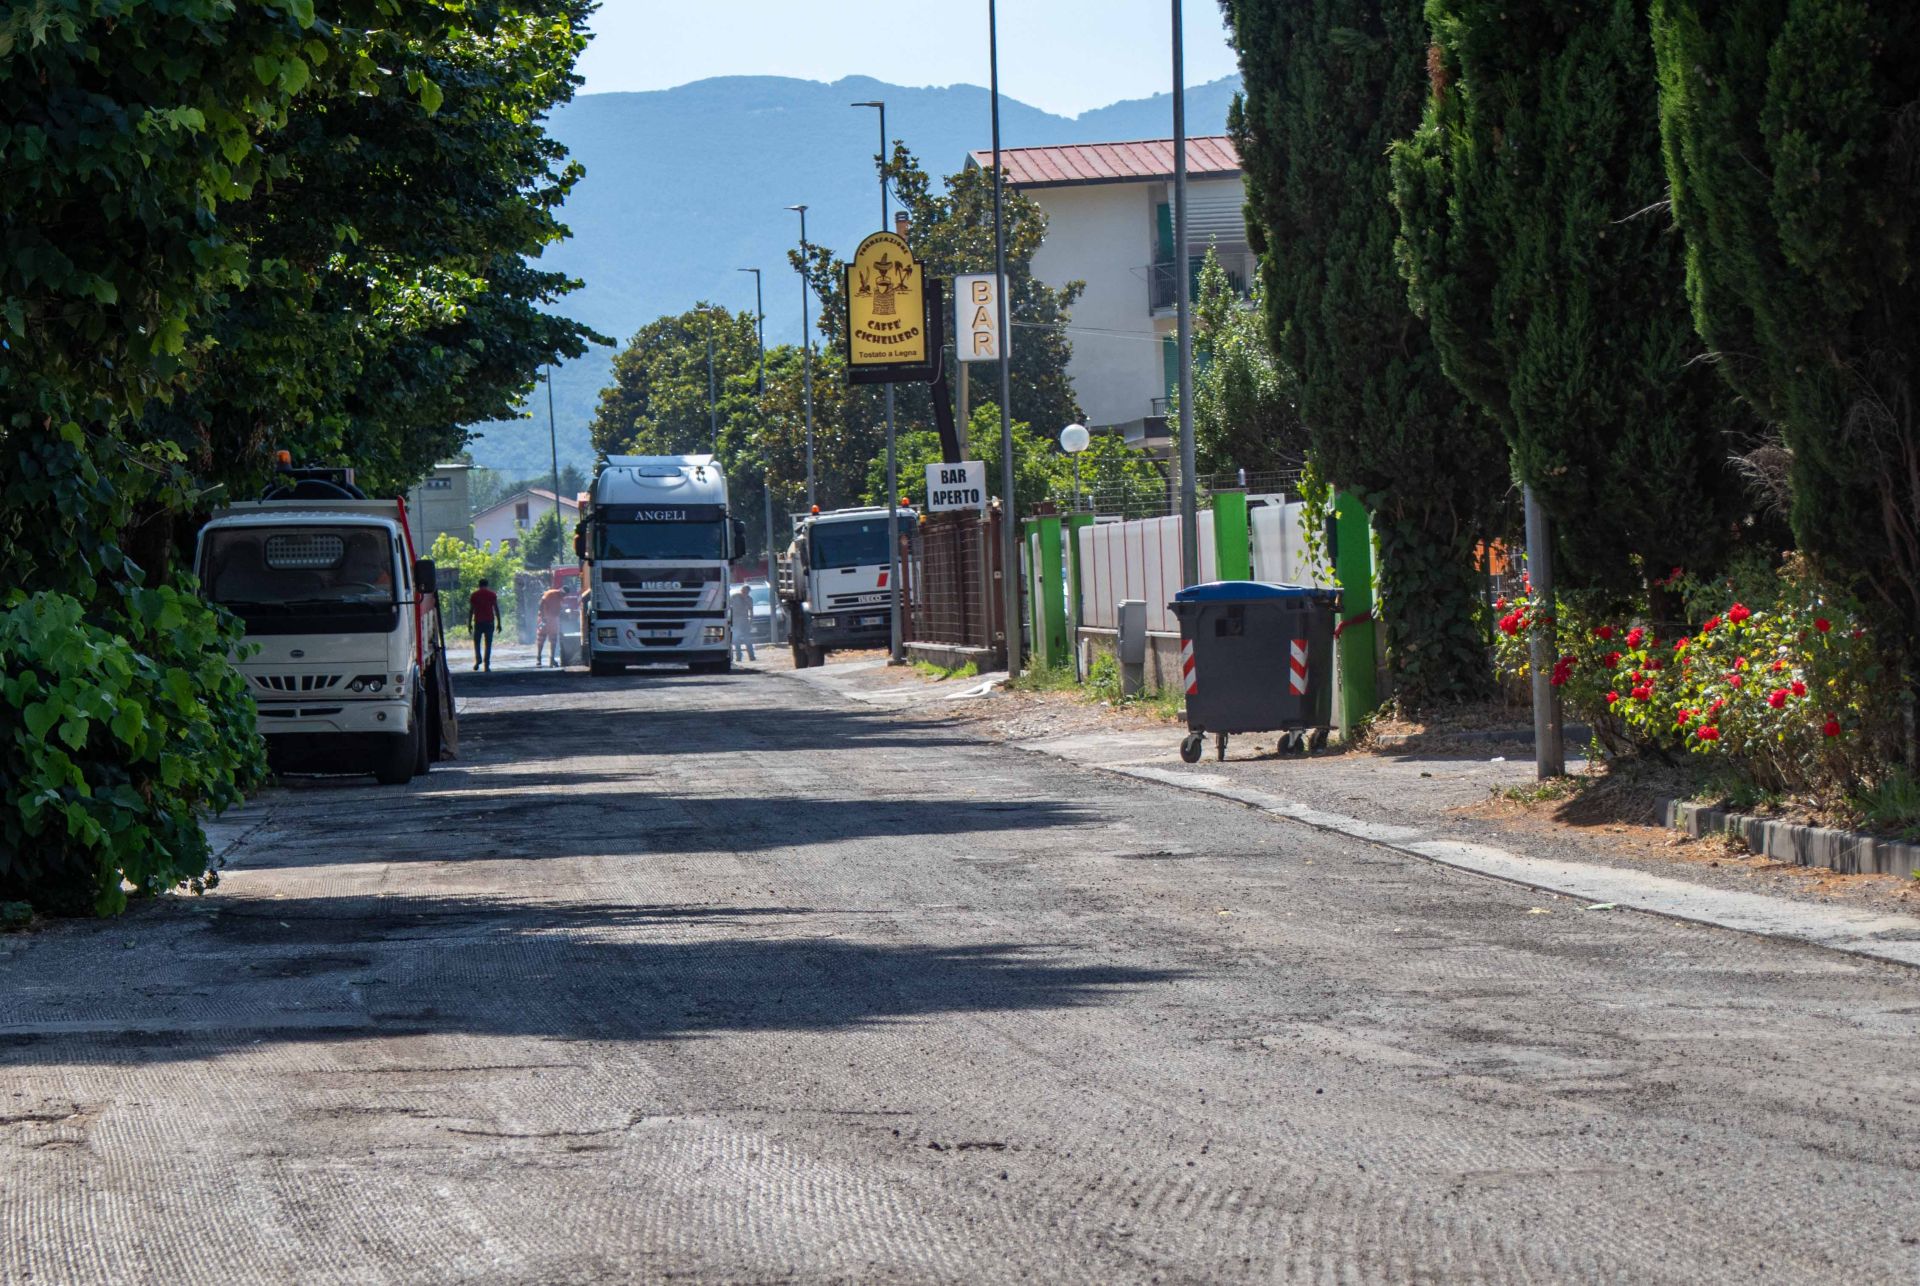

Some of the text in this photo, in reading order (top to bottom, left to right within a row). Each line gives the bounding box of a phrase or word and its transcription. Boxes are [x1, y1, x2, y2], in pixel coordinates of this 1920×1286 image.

[972, 281, 994, 356] BAR
[855, 327, 919, 344] CICHELLERO
[894, 350, 917, 358] Legna
[941, 469, 967, 484] BAR
[932, 489, 980, 506] APERTO
[635, 510, 687, 521] ANGELI
[641, 581, 682, 590] IVECO
